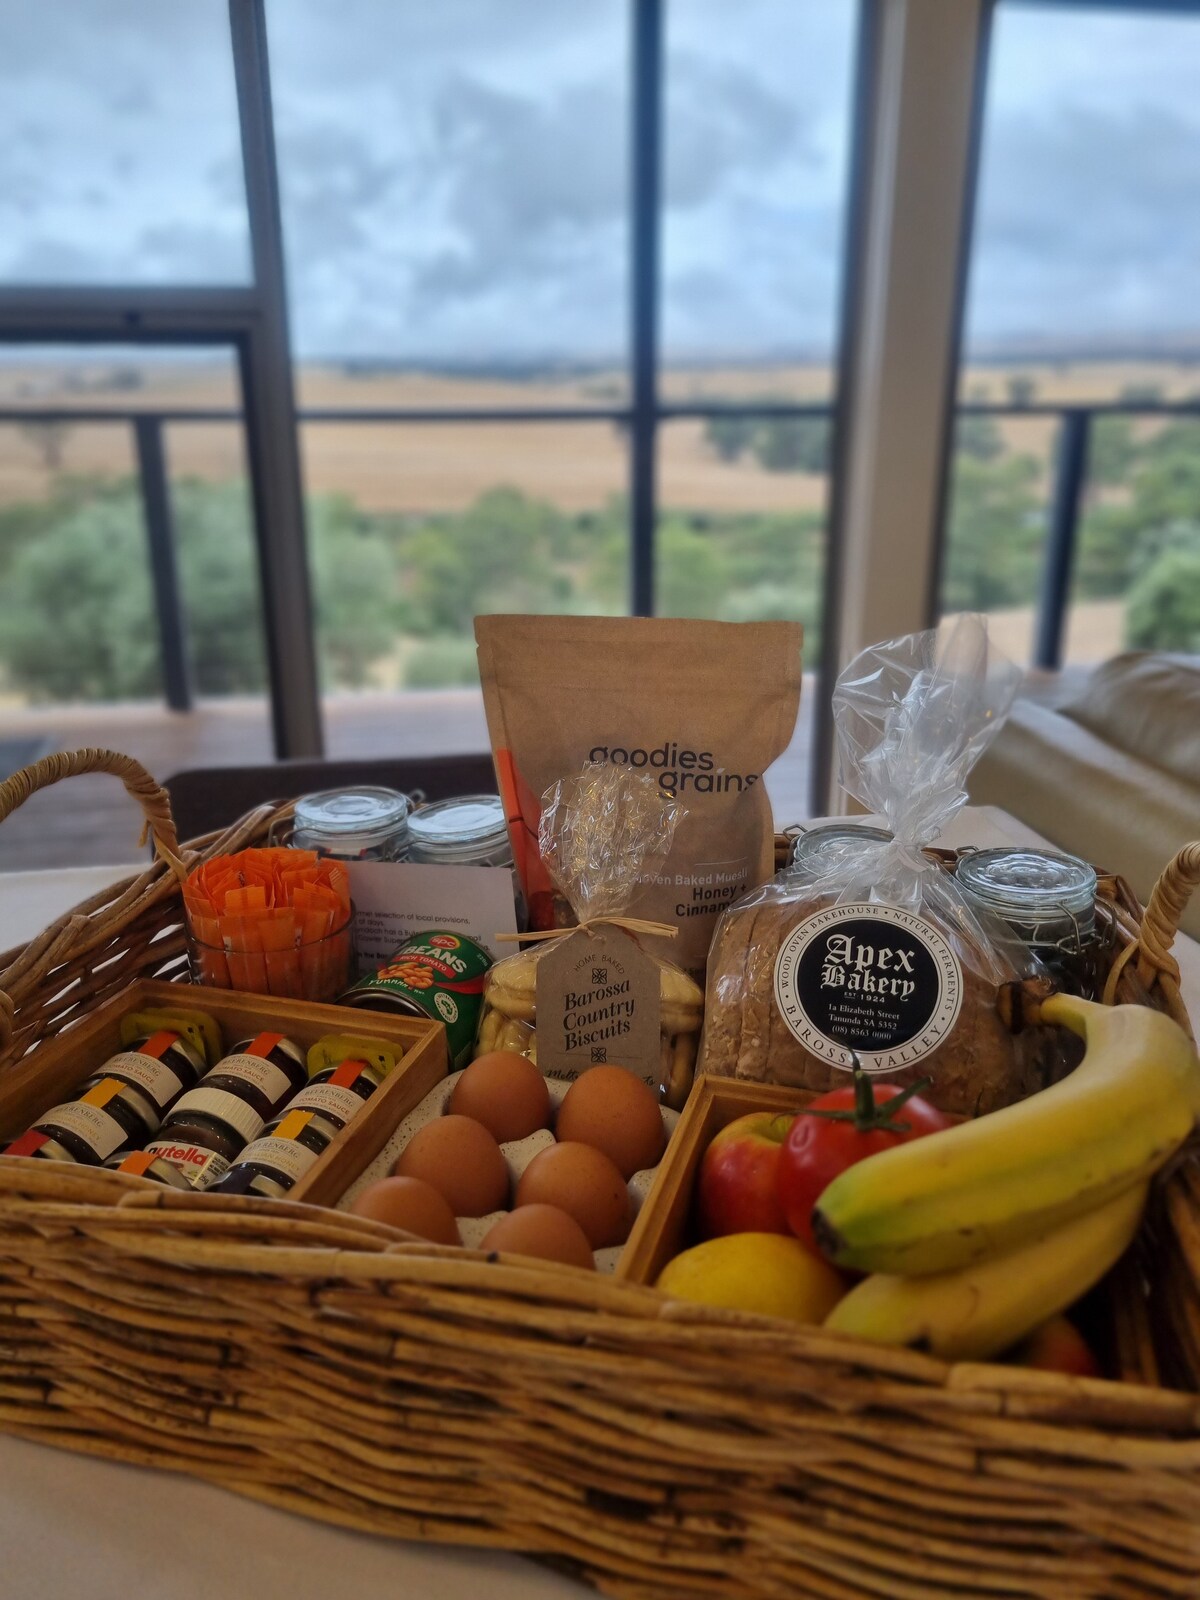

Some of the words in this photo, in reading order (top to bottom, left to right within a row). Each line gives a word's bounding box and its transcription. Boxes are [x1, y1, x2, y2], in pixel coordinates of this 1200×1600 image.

[589, 743, 714, 770] goodies
[658, 769, 758, 798] grains
[675, 871, 712, 886] Baked
[716, 868, 748, 885] Muesli
[693, 885, 738, 901] Honey
[675, 900, 735, 917] Cinnam
[404, 945, 467, 973] BEANS
[419, 955, 447, 972] TOMATO
[782, 956, 792, 989] WOOD
[790, 928, 810, 953] OVEN
[810, 907, 880, 929] BAKEHOUSE
[893, 912, 940, 947] NATURAL
[938, 948, 957, 1012] FERMENTS
[825, 933, 915, 973] Apex
[573, 954, 596, 973] HOME
[602, 954, 625, 975] BAKED
[820, 963, 916, 1002] Bakery
[564, 979, 630, 1012] Barossa
[860, 993, 885, 1004] 1924
[563, 999, 635, 1032] Country
[828, 1014, 861, 1025] Tanunda
[864, 1018, 875, 1028] SA
[878, 1020, 897, 1030] 5352
[839, 1004, 875, 1017] Elizabeth
[877, 1008, 900, 1020] Street
[564, 1019, 631, 1051] Biscuits
[785, 1004, 856, 1066] BAROSS
[874, 1024, 942, 1068] VALLEY
[832, 1025, 848, 1035] (08)
[850, 1027, 869, 1038] 8563
[327, 1100, 350, 1116] SAUCE
[148, 1146, 209, 1167] nutella
